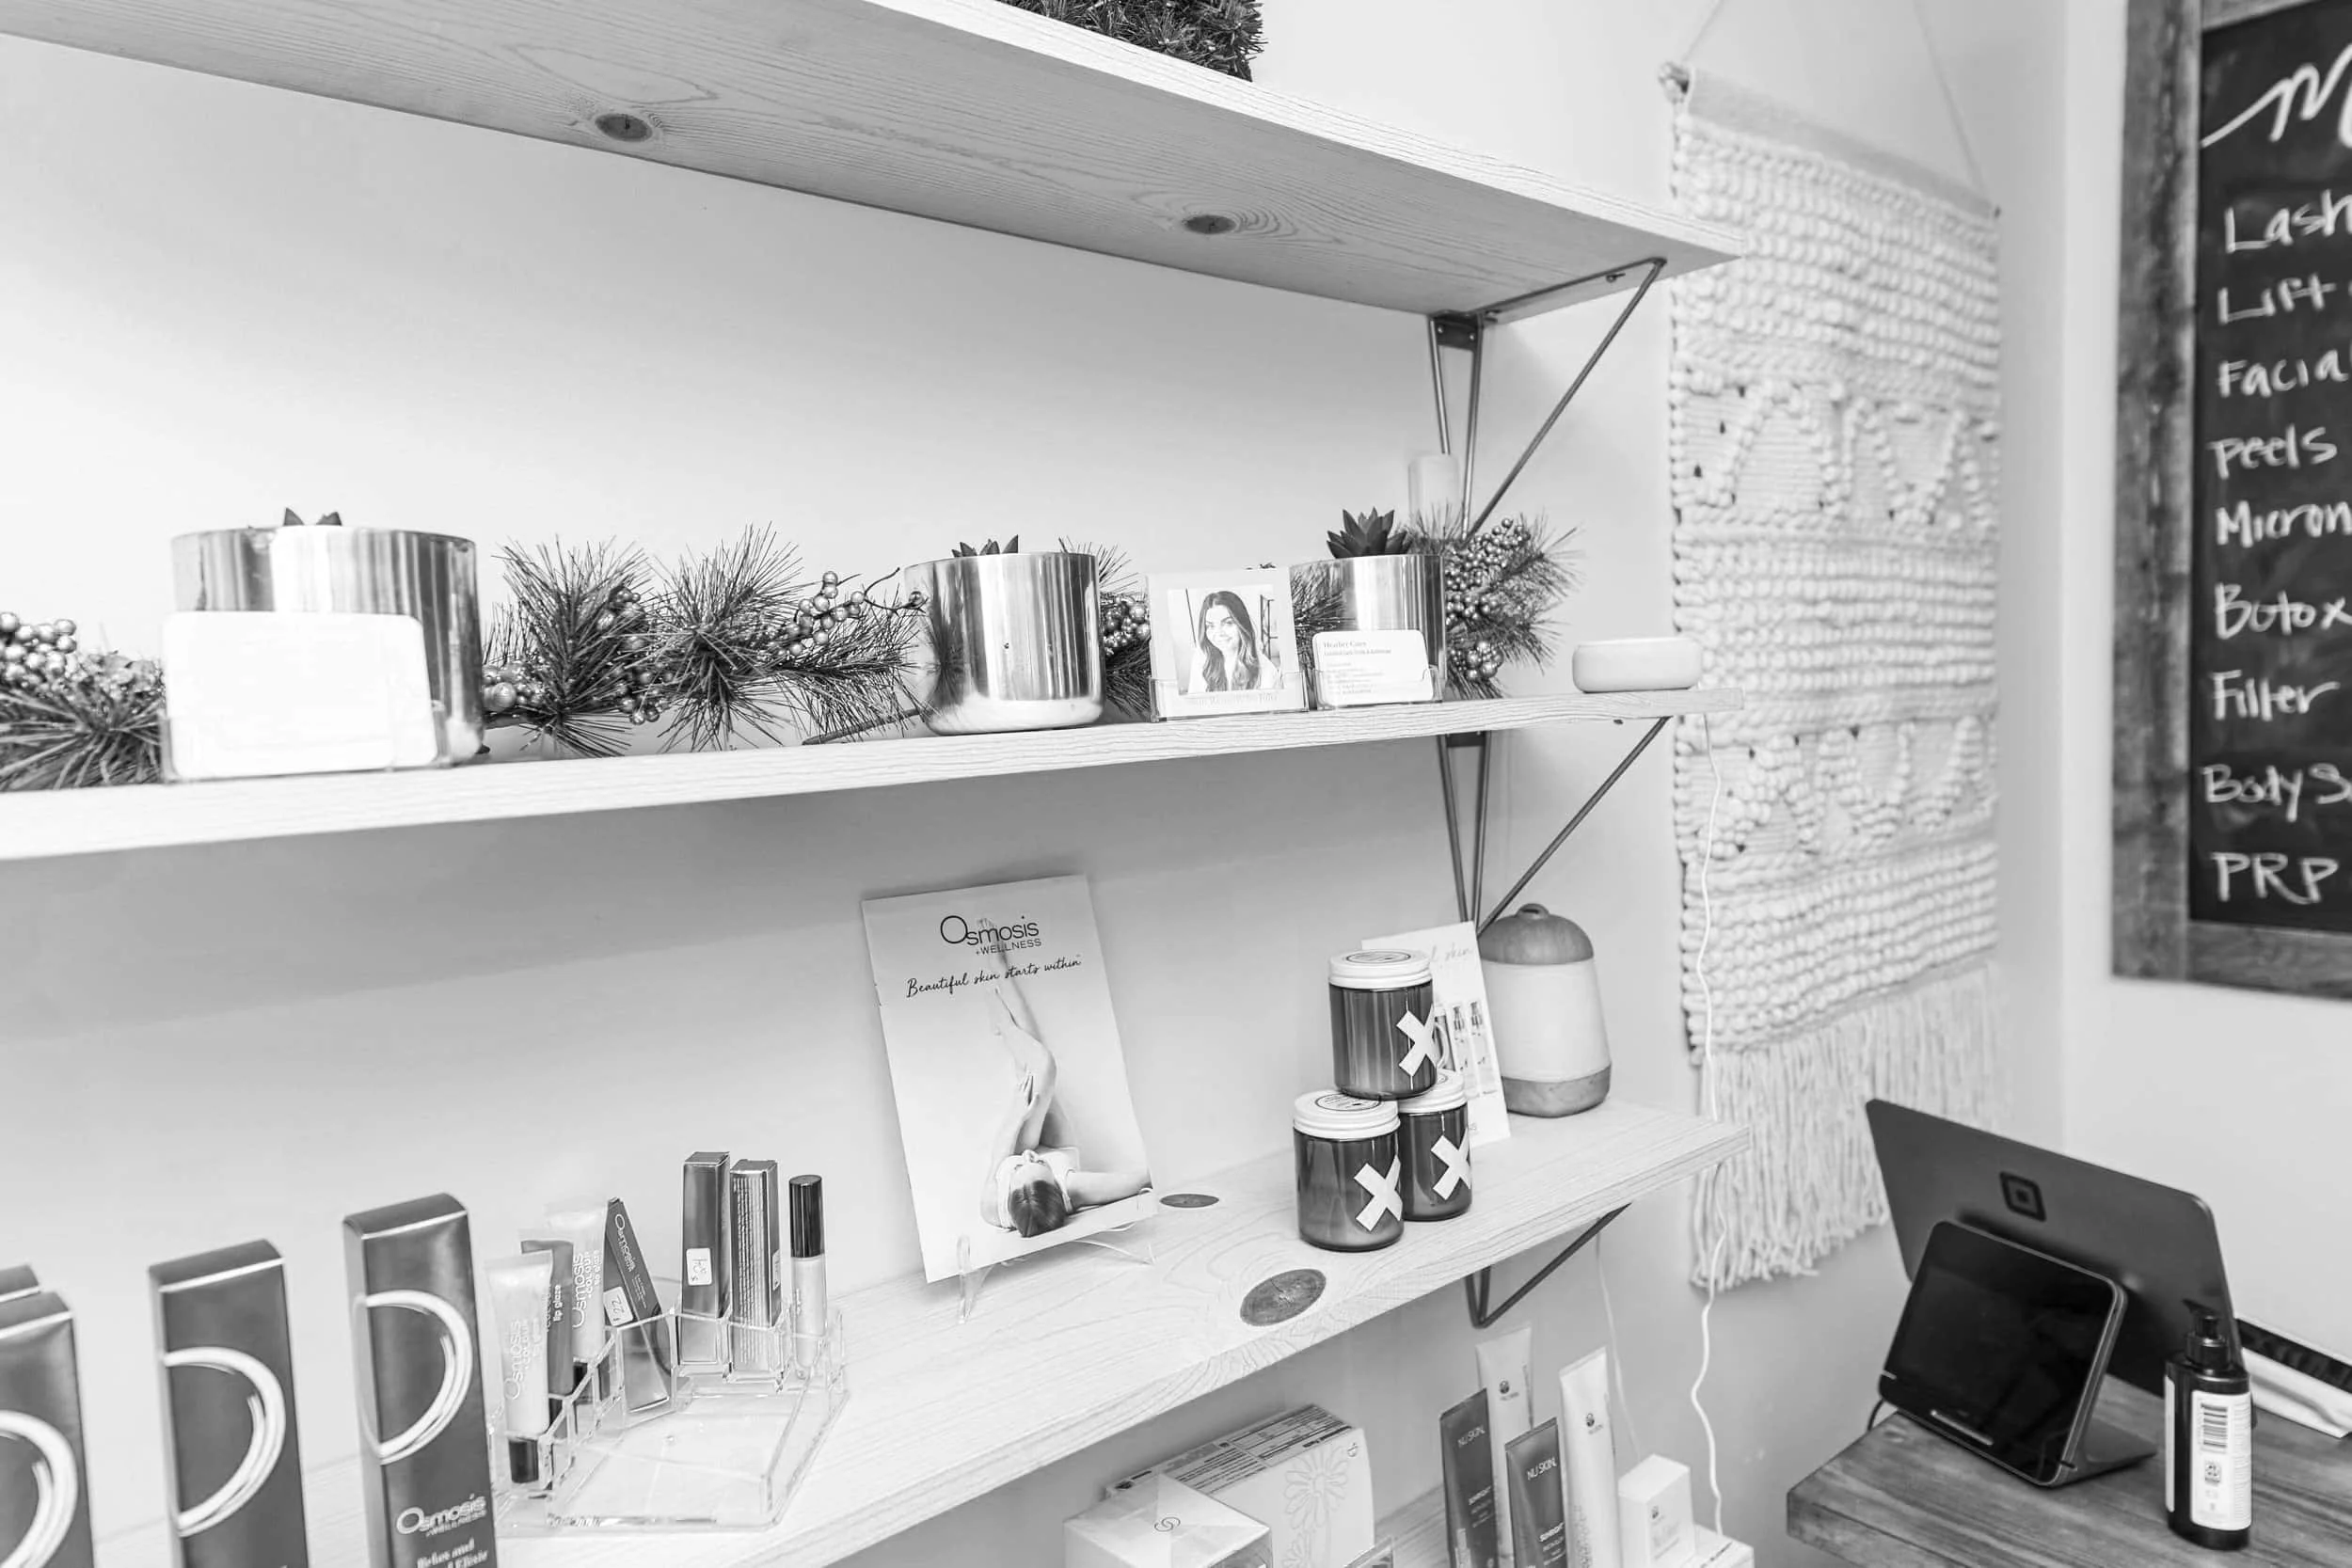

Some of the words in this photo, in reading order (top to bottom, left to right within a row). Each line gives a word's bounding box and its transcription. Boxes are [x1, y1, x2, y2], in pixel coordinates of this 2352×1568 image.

[2224, 189, 2352, 254] Lash
[2215, 339, 2352, 398] Facia
[2214, 582, 2352, 640] Botox
[2208, 669, 2341, 721] Filler
[2201, 763, 2303, 822] Body
[2212, 851, 2338, 904] PRP
[940, 914, 1040, 946] Osmosis
[906, 973, 969, 998] Beautiful
[974, 970, 1000, 985] skin
[1005, 962, 1040, 978] starts
[1044, 956, 1081, 972] within
[396, 1493, 486, 1535] Osmosis
